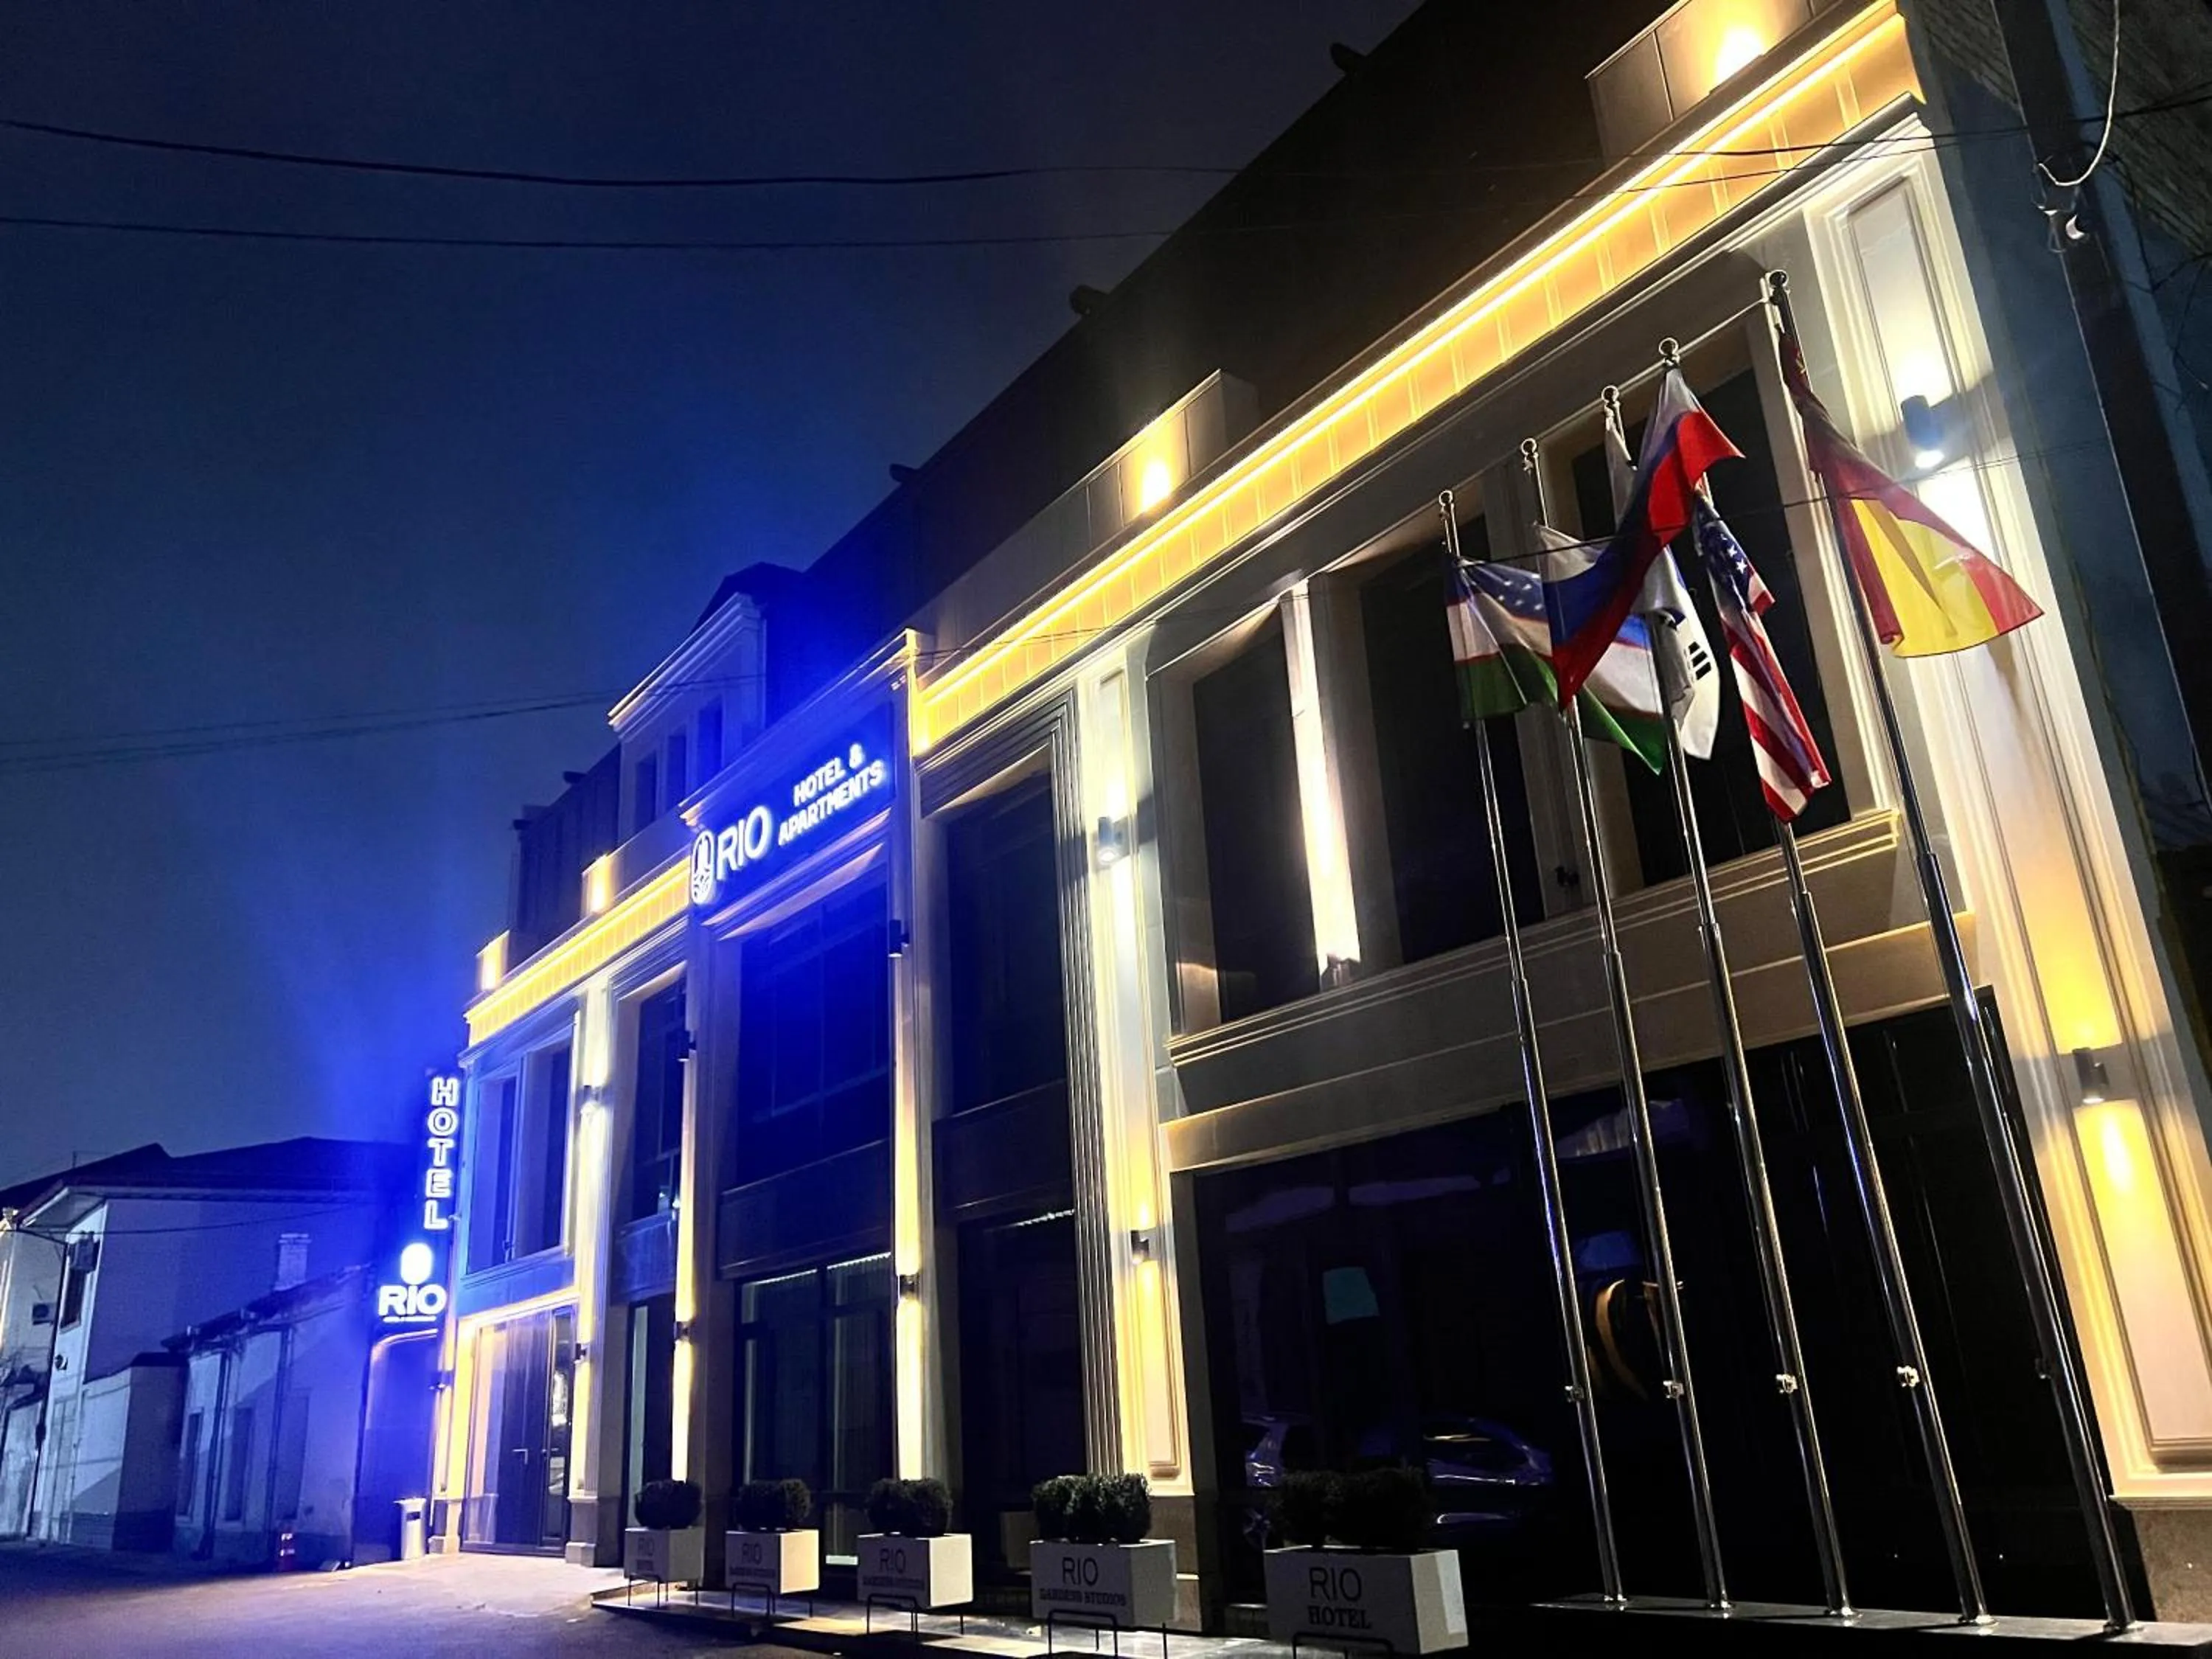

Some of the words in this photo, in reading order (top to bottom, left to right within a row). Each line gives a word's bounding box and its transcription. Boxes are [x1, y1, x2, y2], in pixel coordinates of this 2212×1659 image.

[793, 757, 846, 807] HOTEL
[849, 742, 865, 769] &
[778, 759, 885, 846] APARTMENTS
[716, 805, 771, 881] RIO
[424, 1077, 460, 1231] HOTEL
[378, 1283, 448, 1316] RIO
[741, 1543, 762, 1565] RIO
[879, 1548, 907, 1574] RIO
[1062, 1557, 1099, 1587] RIO
[1309, 1566, 1363, 1601] RIO
[1307, 1605, 1373, 1630] HOTEL
